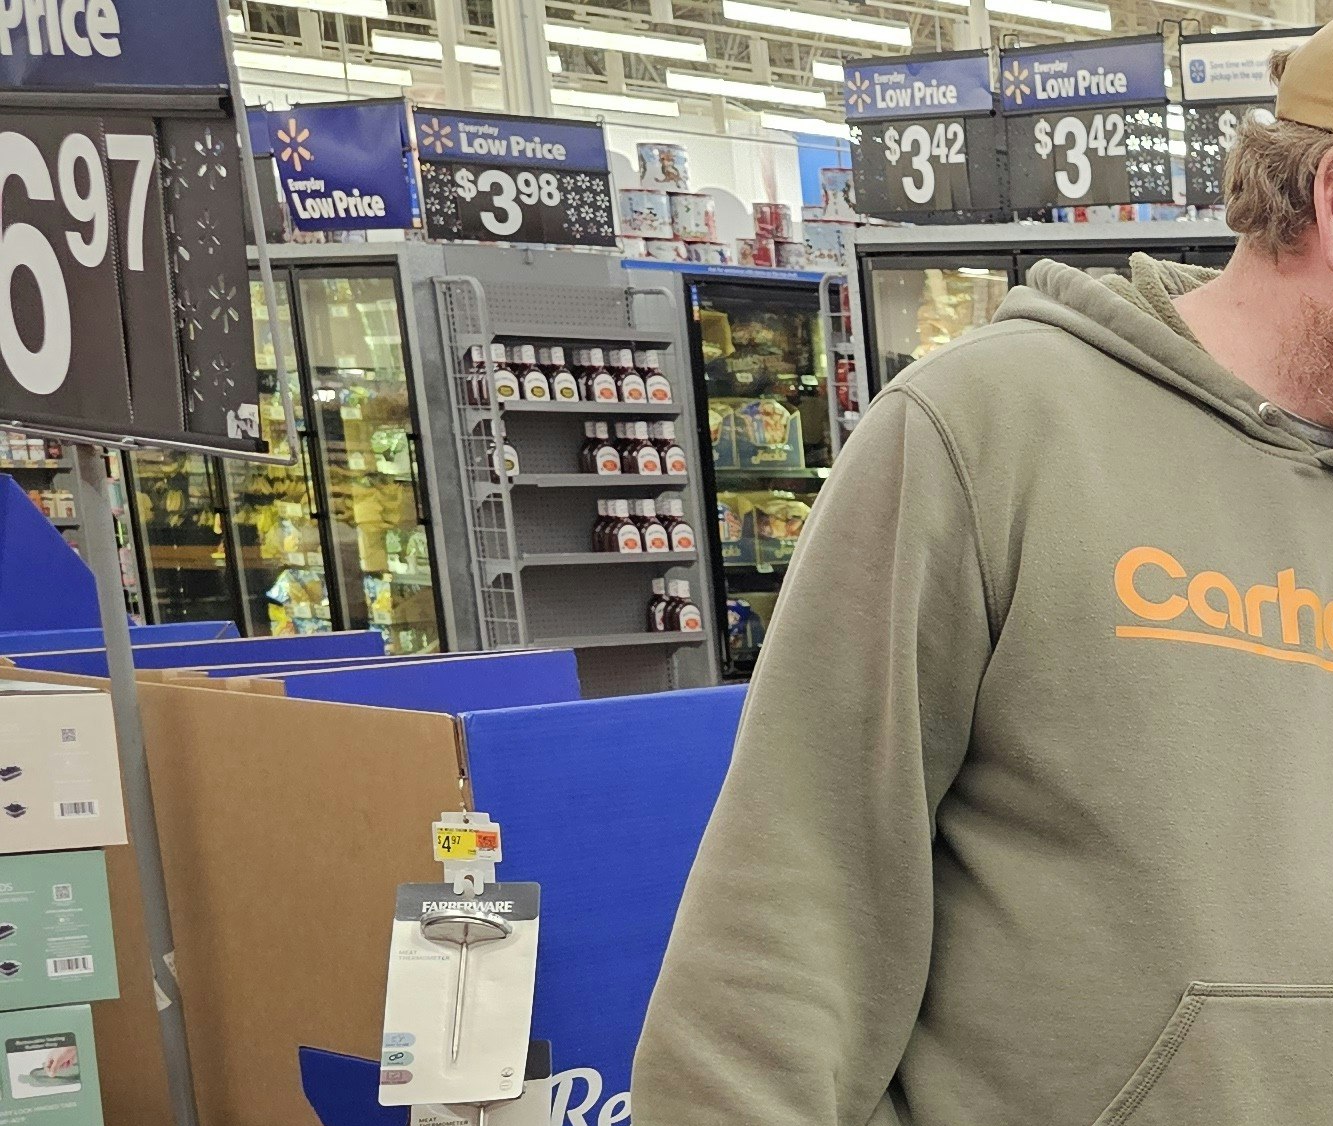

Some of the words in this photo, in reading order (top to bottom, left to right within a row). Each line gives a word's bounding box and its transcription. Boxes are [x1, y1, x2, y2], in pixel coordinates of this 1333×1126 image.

[873, 71, 906, 86] Everyday
[1033, 59, 1069, 75] Everyday
[875, 81, 912, 109] Low
[913, 80, 958, 106] Price
[1035, 70, 1079, 100] Low
[1079, 66, 1127, 97] Price
[458, 122, 499, 137] Everyday
[459, 132, 508, 157] Low
[509, 136, 567, 161] Price
[287, 177, 325, 194] Everyday
[293, 193, 335, 220] Low
[337, 189, 385, 218] Price
